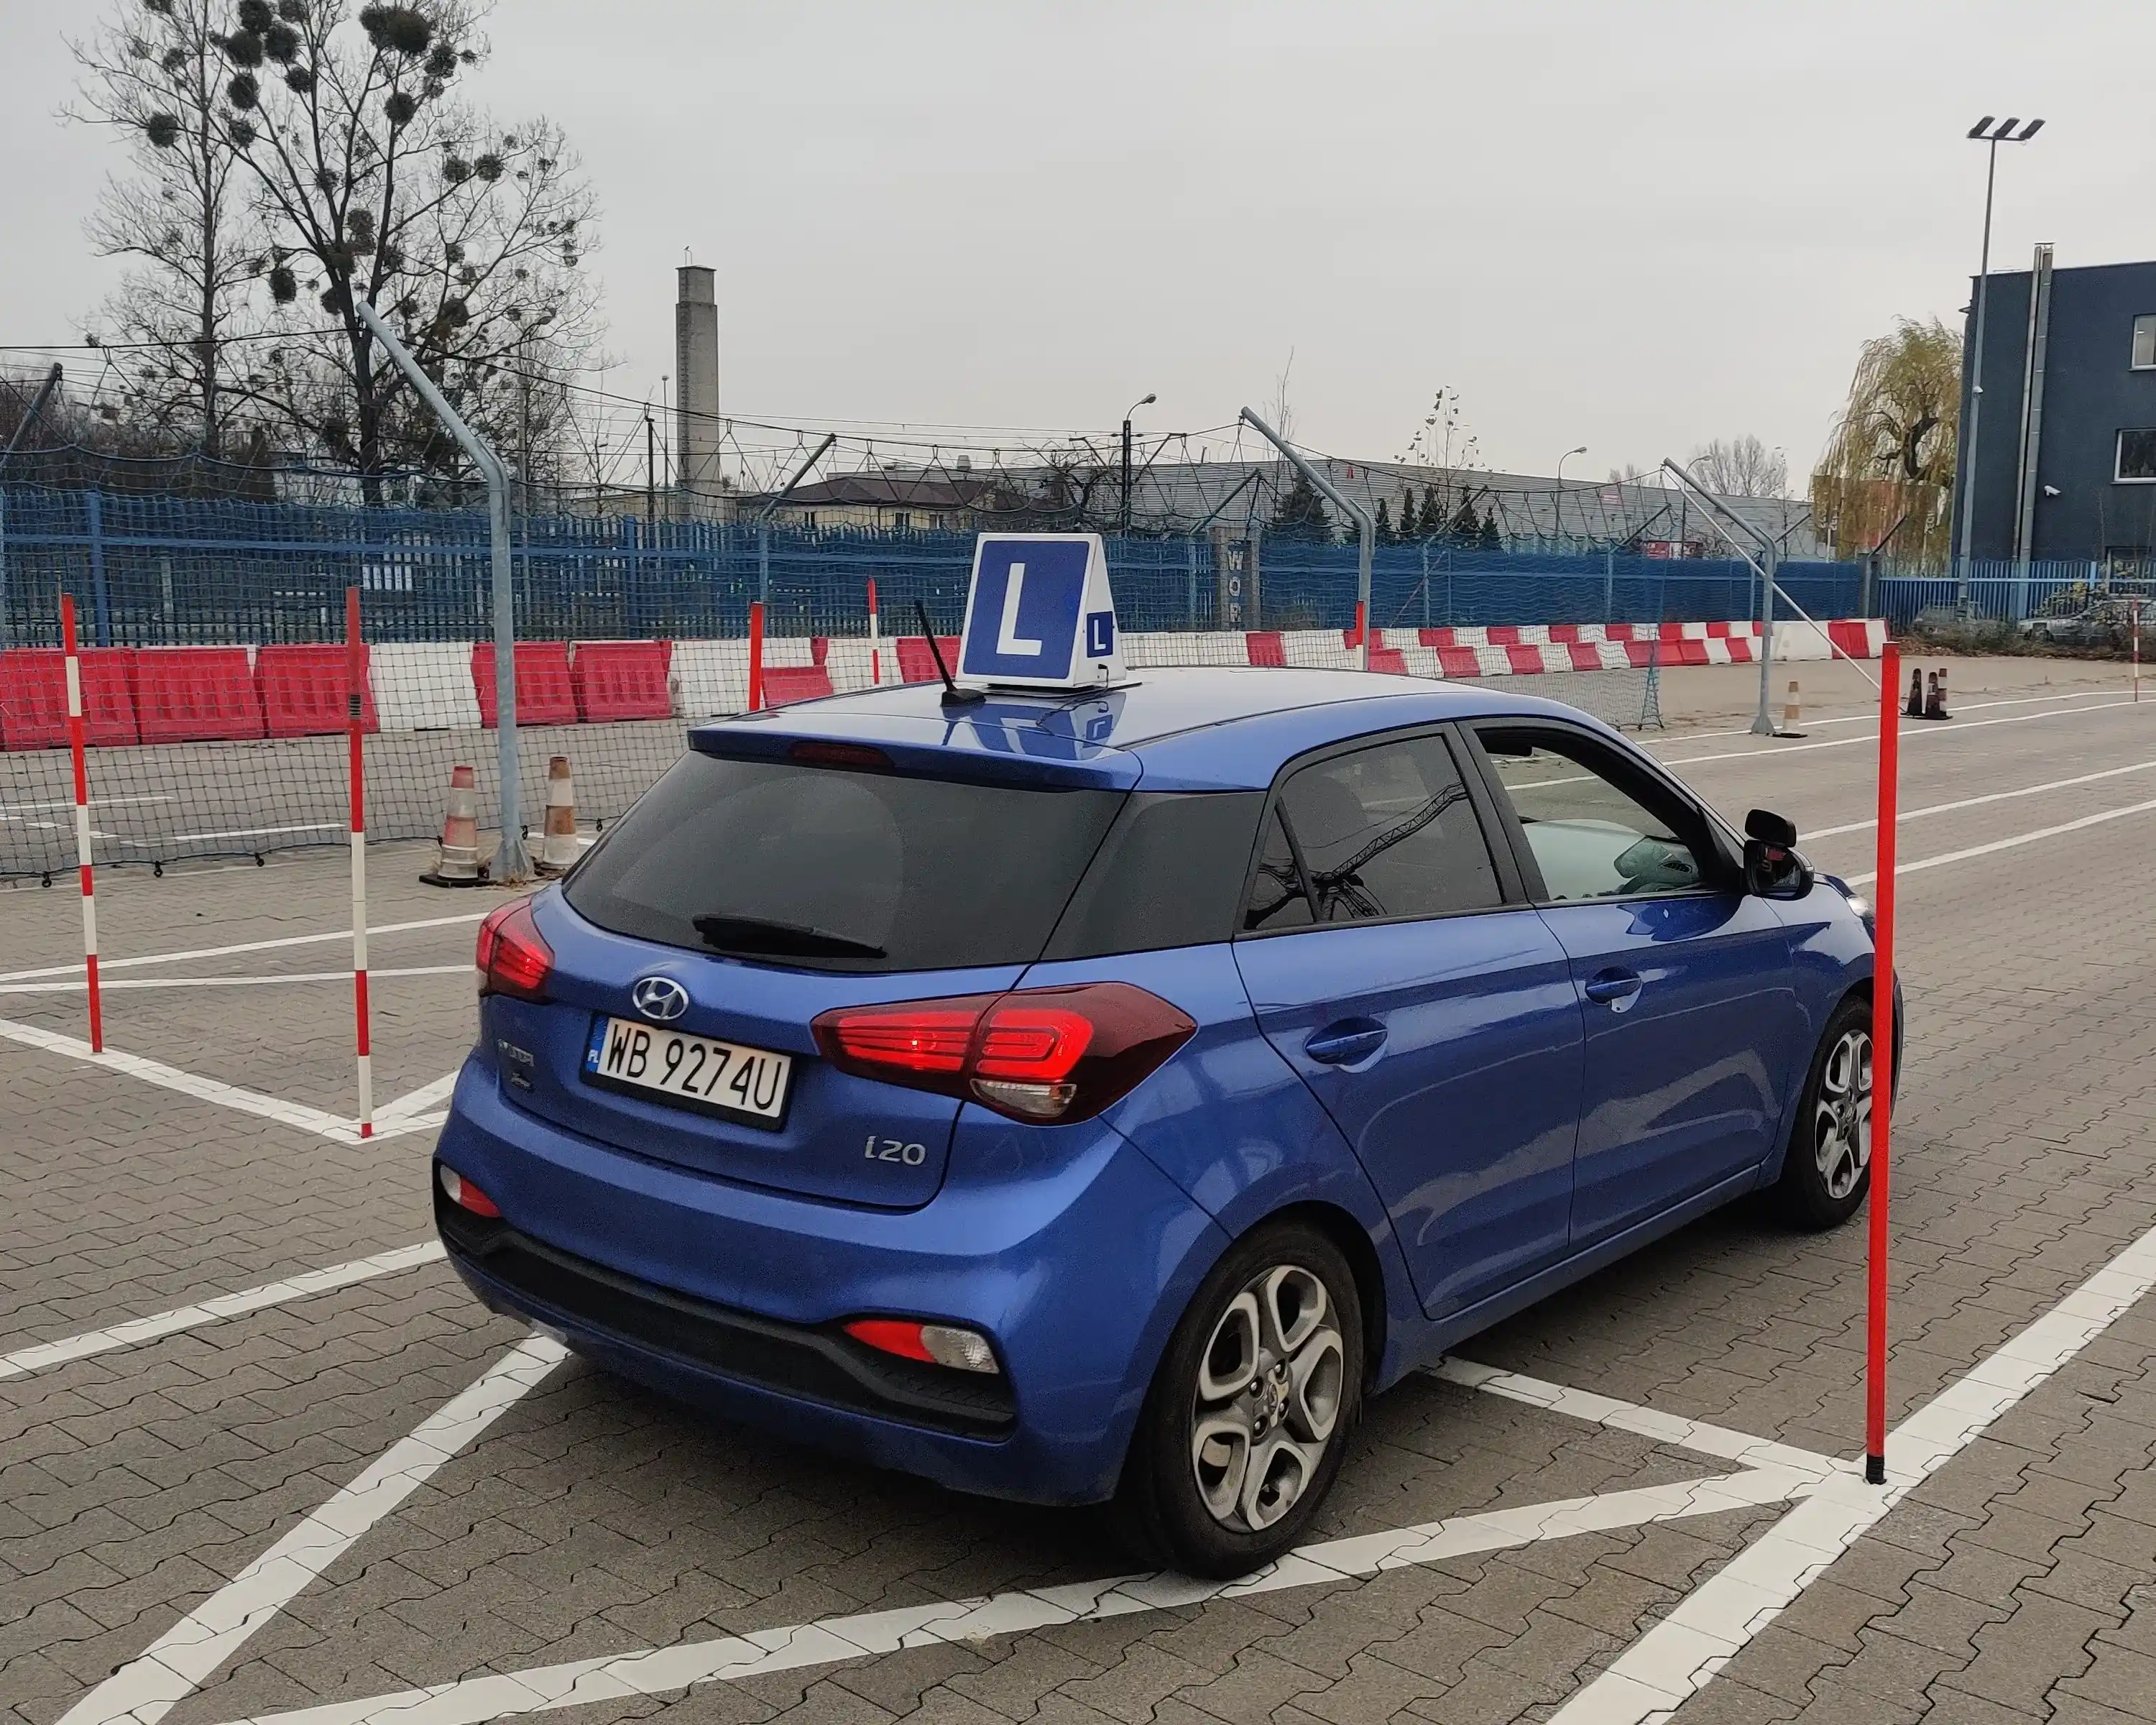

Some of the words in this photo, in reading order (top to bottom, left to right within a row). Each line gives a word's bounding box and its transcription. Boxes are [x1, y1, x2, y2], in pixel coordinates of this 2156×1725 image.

[996, 563, 1042, 656] L
[1227, 551, 1244, 630] WOR
[1094, 620, 1106, 650] L
[587, 1049, 599, 1063] PL
[607, 1024, 650, 1078] WB
[660, 1039, 781, 1110] 9274U
[865, 1136, 926, 1166] i20
